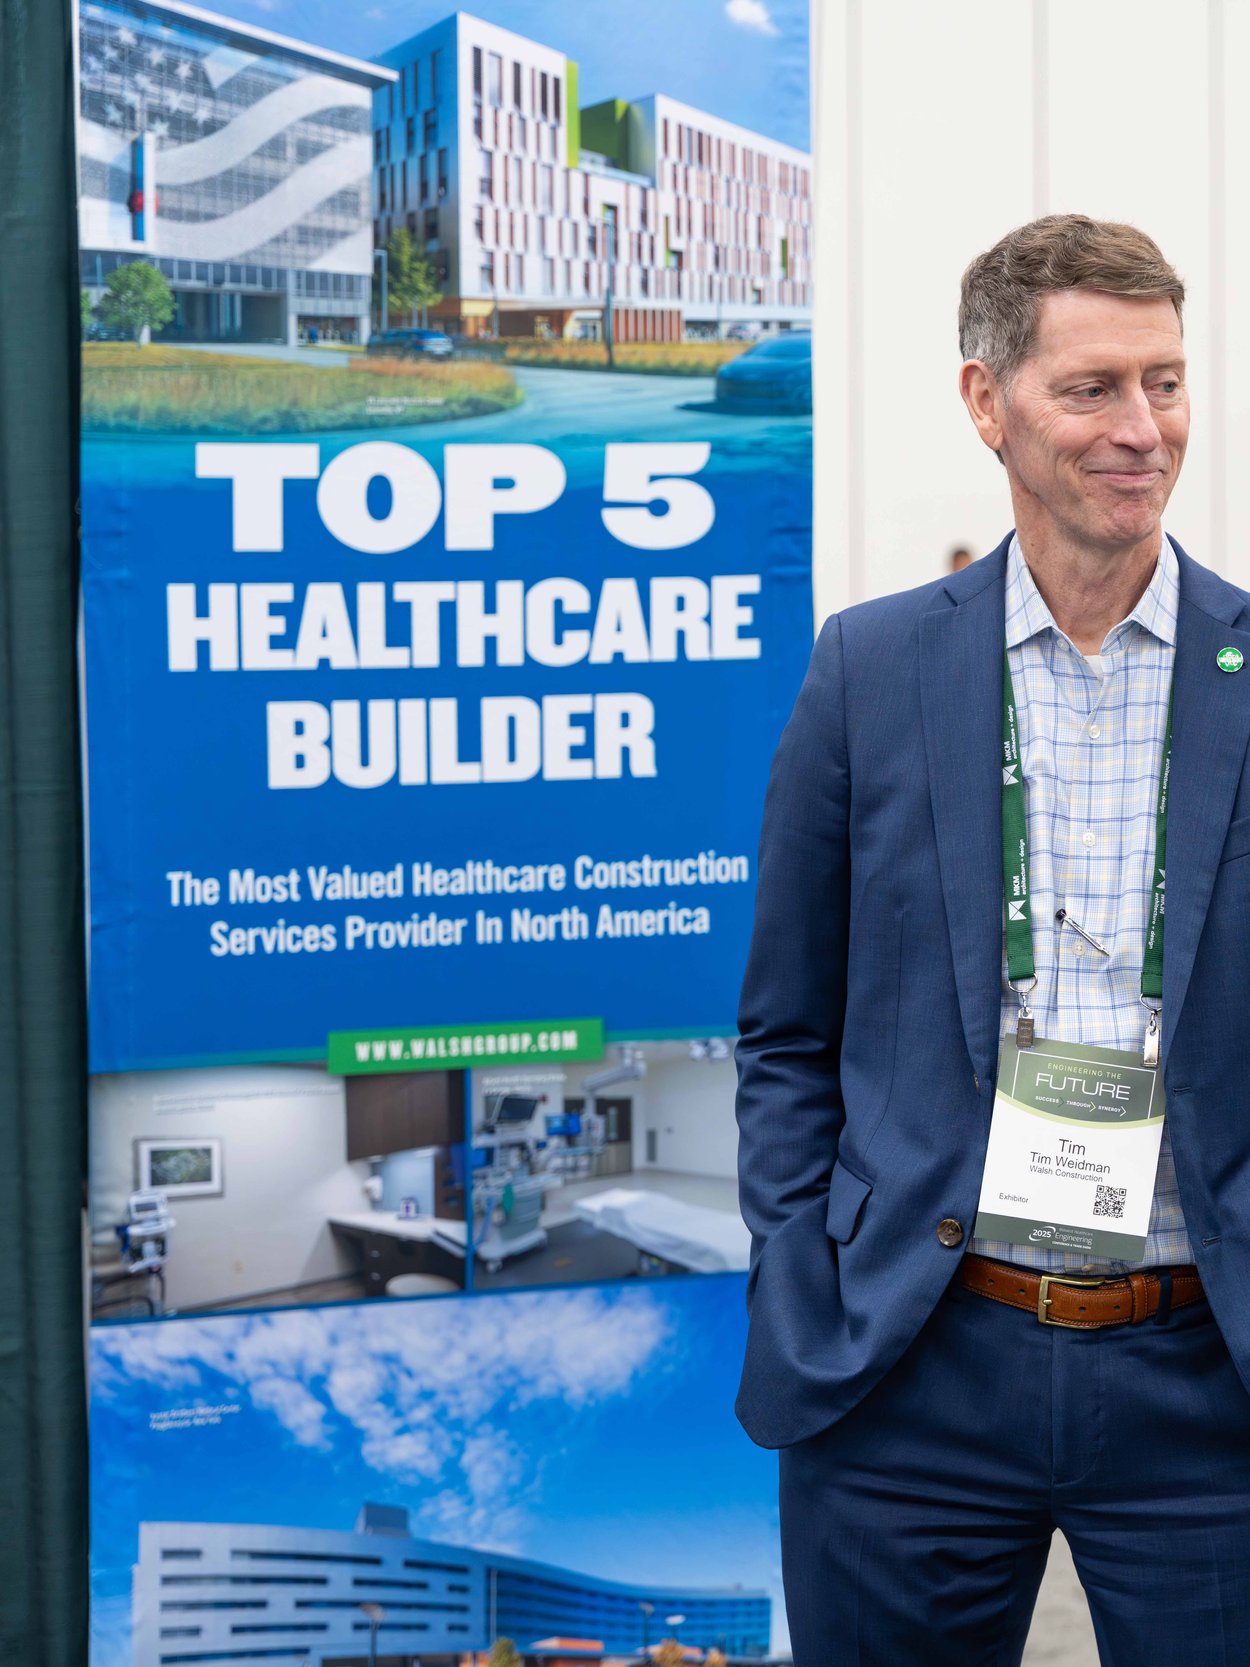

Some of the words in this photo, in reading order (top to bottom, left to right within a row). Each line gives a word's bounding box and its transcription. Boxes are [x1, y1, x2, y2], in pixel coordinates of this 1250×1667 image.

[195, 441, 566, 554] TOP
[601, 442, 715, 551] 5
[166, 575, 762, 672] HEALTHCARE
[266, 692, 657, 790] BUILDER
[166, 871, 221, 907] The
[229, 868, 301, 904] Most
[307, 863, 404, 901] Valued
[412, 859, 566, 897] Healthcare
[574, 849, 748, 890] Construction
[1152, 892, 1160, 925] architecture
[210, 918, 337, 957] Services
[345, 912, 468, 951] Provider
[476, 909, 503, 945] In
[511, 905, 589, 943] North
[595, 900, 710, 939] America
[355, 1030, 578, 1062] WWW.WALSHGROUP.COM
[1047, 1062, 1103, 1077] ENGINEERING
[1106, 1072, 1122, 1080] THE
[1035, 1072, 1131, 1101] FUTURE
[1035, 1095, 1059, 1104] SUCCESS
[1066, 1100, 1091, 1109] THROUGH
[1098, 1105, 1121, 1113] SYNERGY
[1059, 1138, 1086, 1156] Tim
[1030, 1151, 1052, 1165] Tim
[1056, 1155, 1111, 1174] Weidman
[1030, 1165, 1053, 1175] Walsh
[1055, 1168, 1103, 1182] Construction
[999, 1192, 1029, 1203] Exhibitor
[1033, 1229, 1052, 1238] 2025
[1055, 1232, 1093, 1245] Engineering
